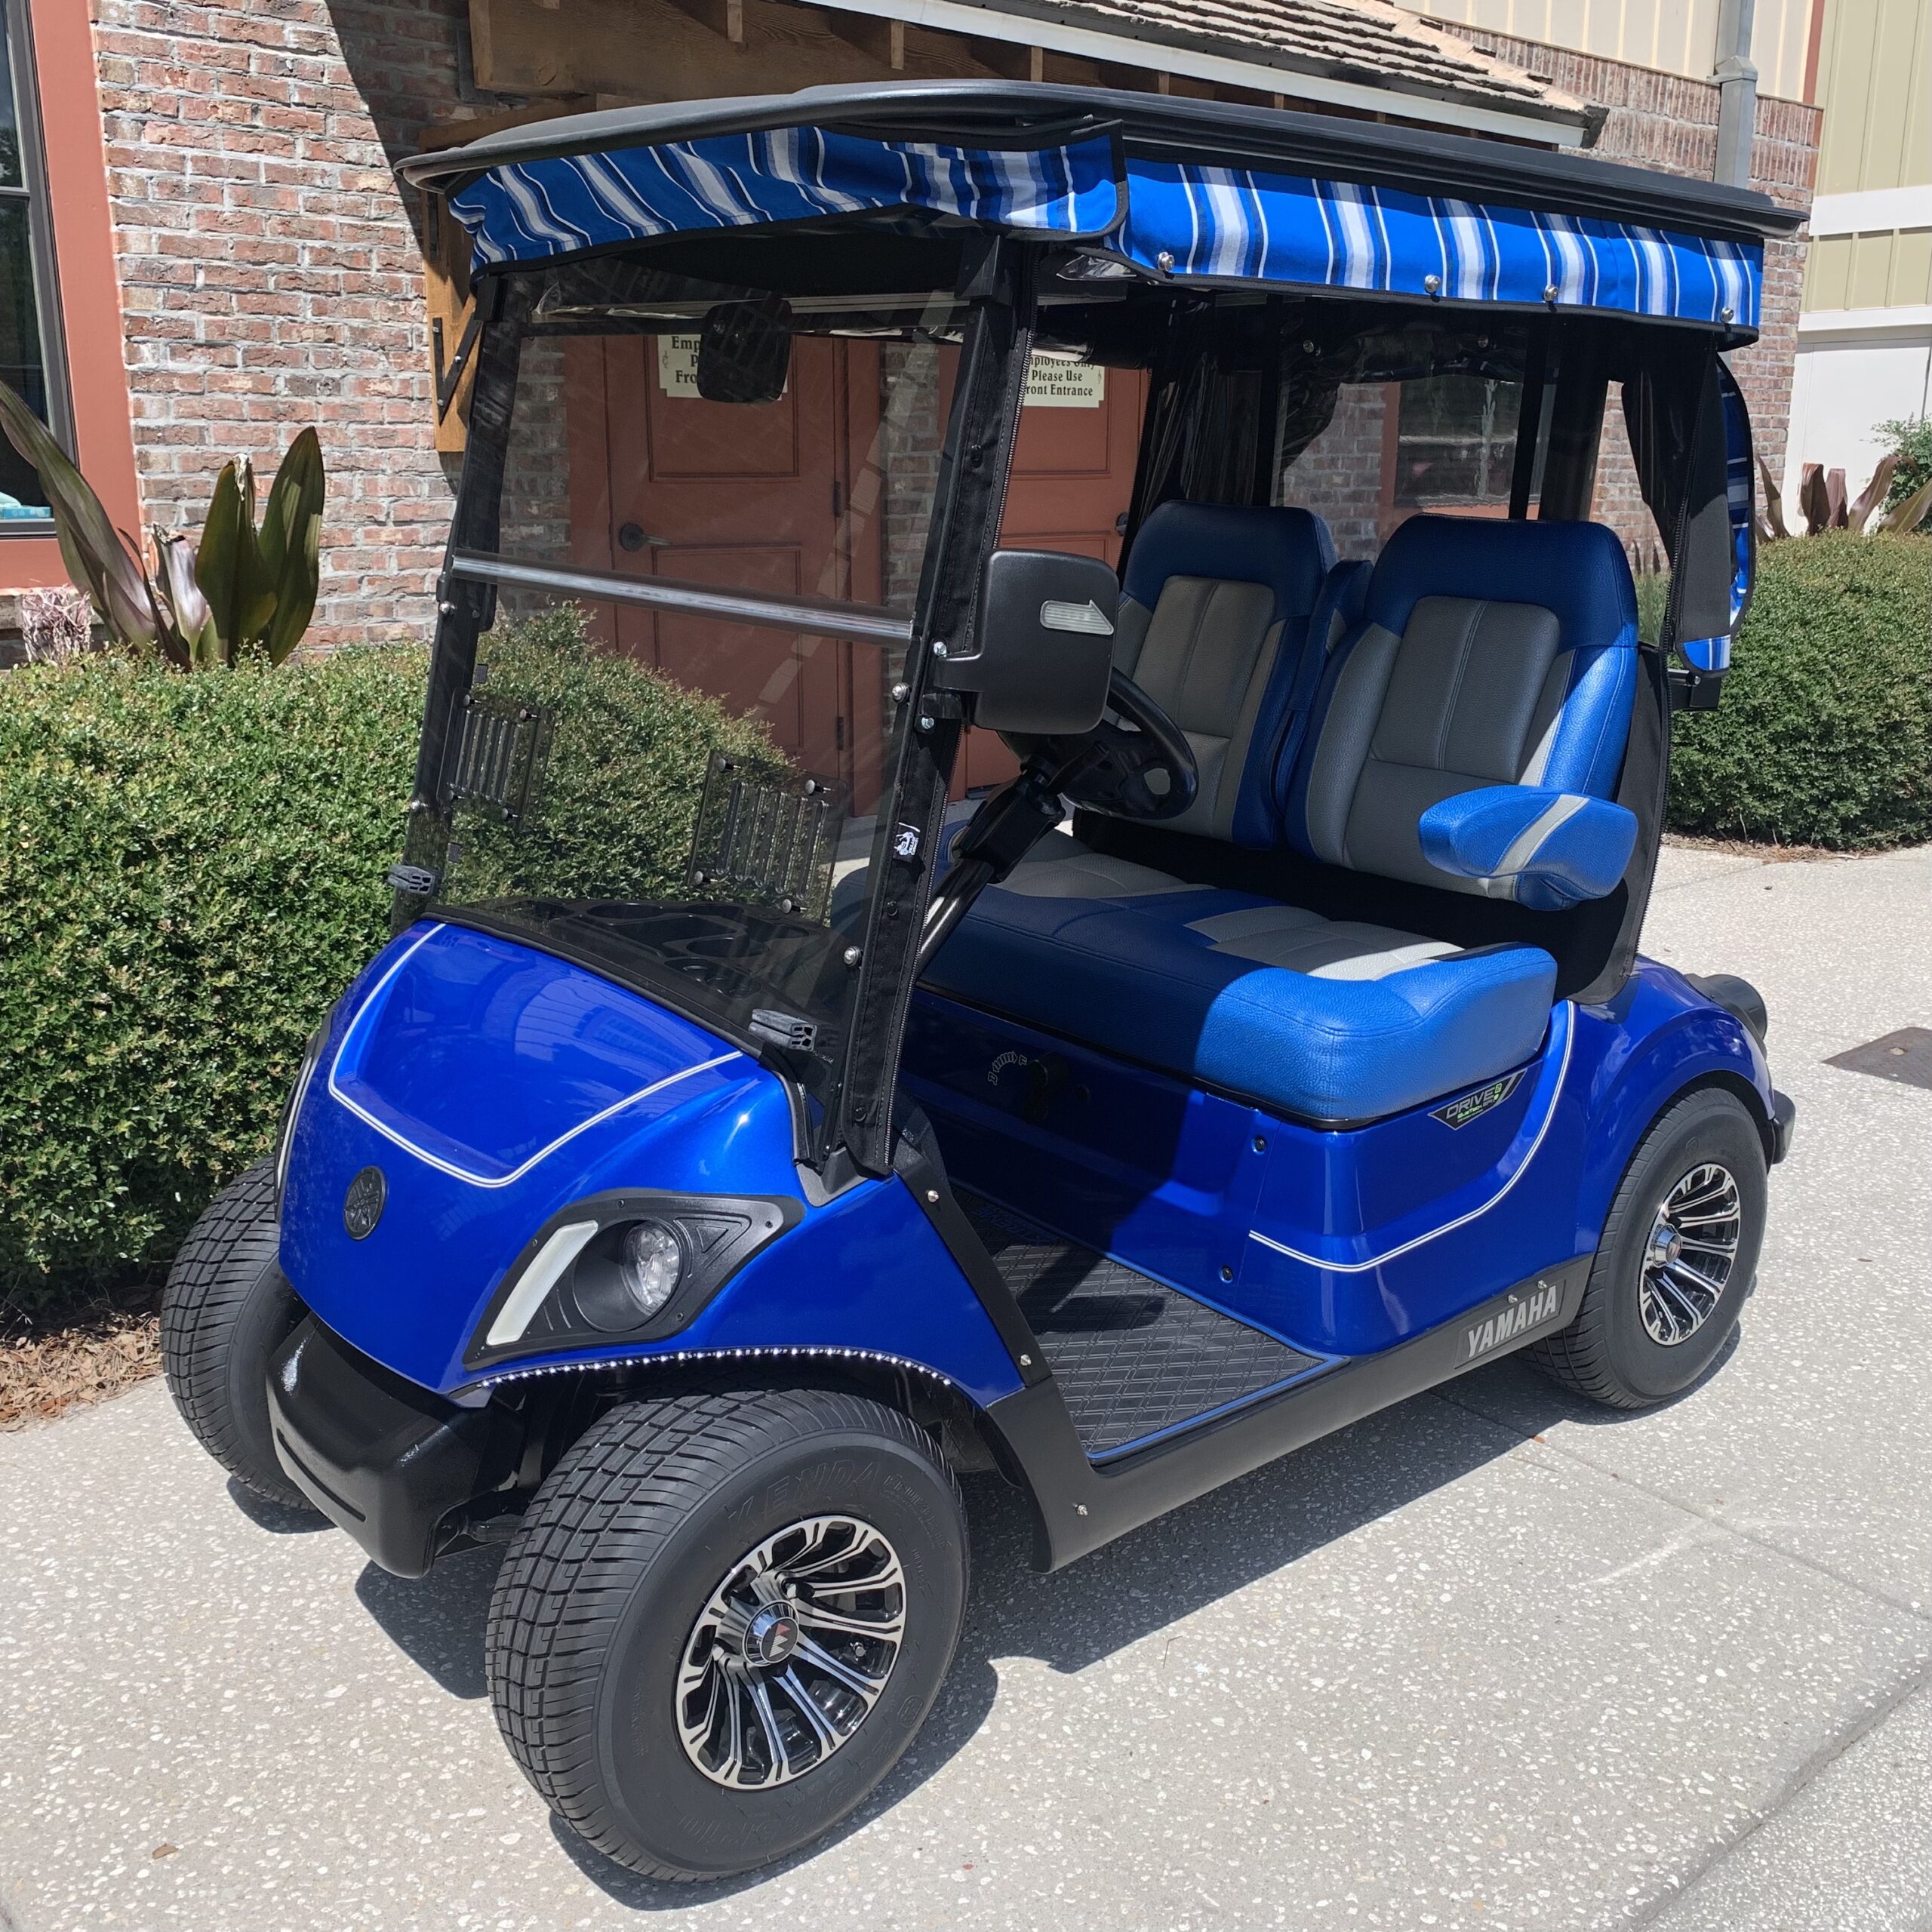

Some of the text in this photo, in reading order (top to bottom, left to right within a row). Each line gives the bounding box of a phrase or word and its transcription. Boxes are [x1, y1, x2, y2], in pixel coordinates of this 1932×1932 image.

[1032, 369, 1082, 381] Please Use
[1026, 384, 1093, 396] ront Entrance
[1468, 1285, 1556, 1358] YAMAHA
